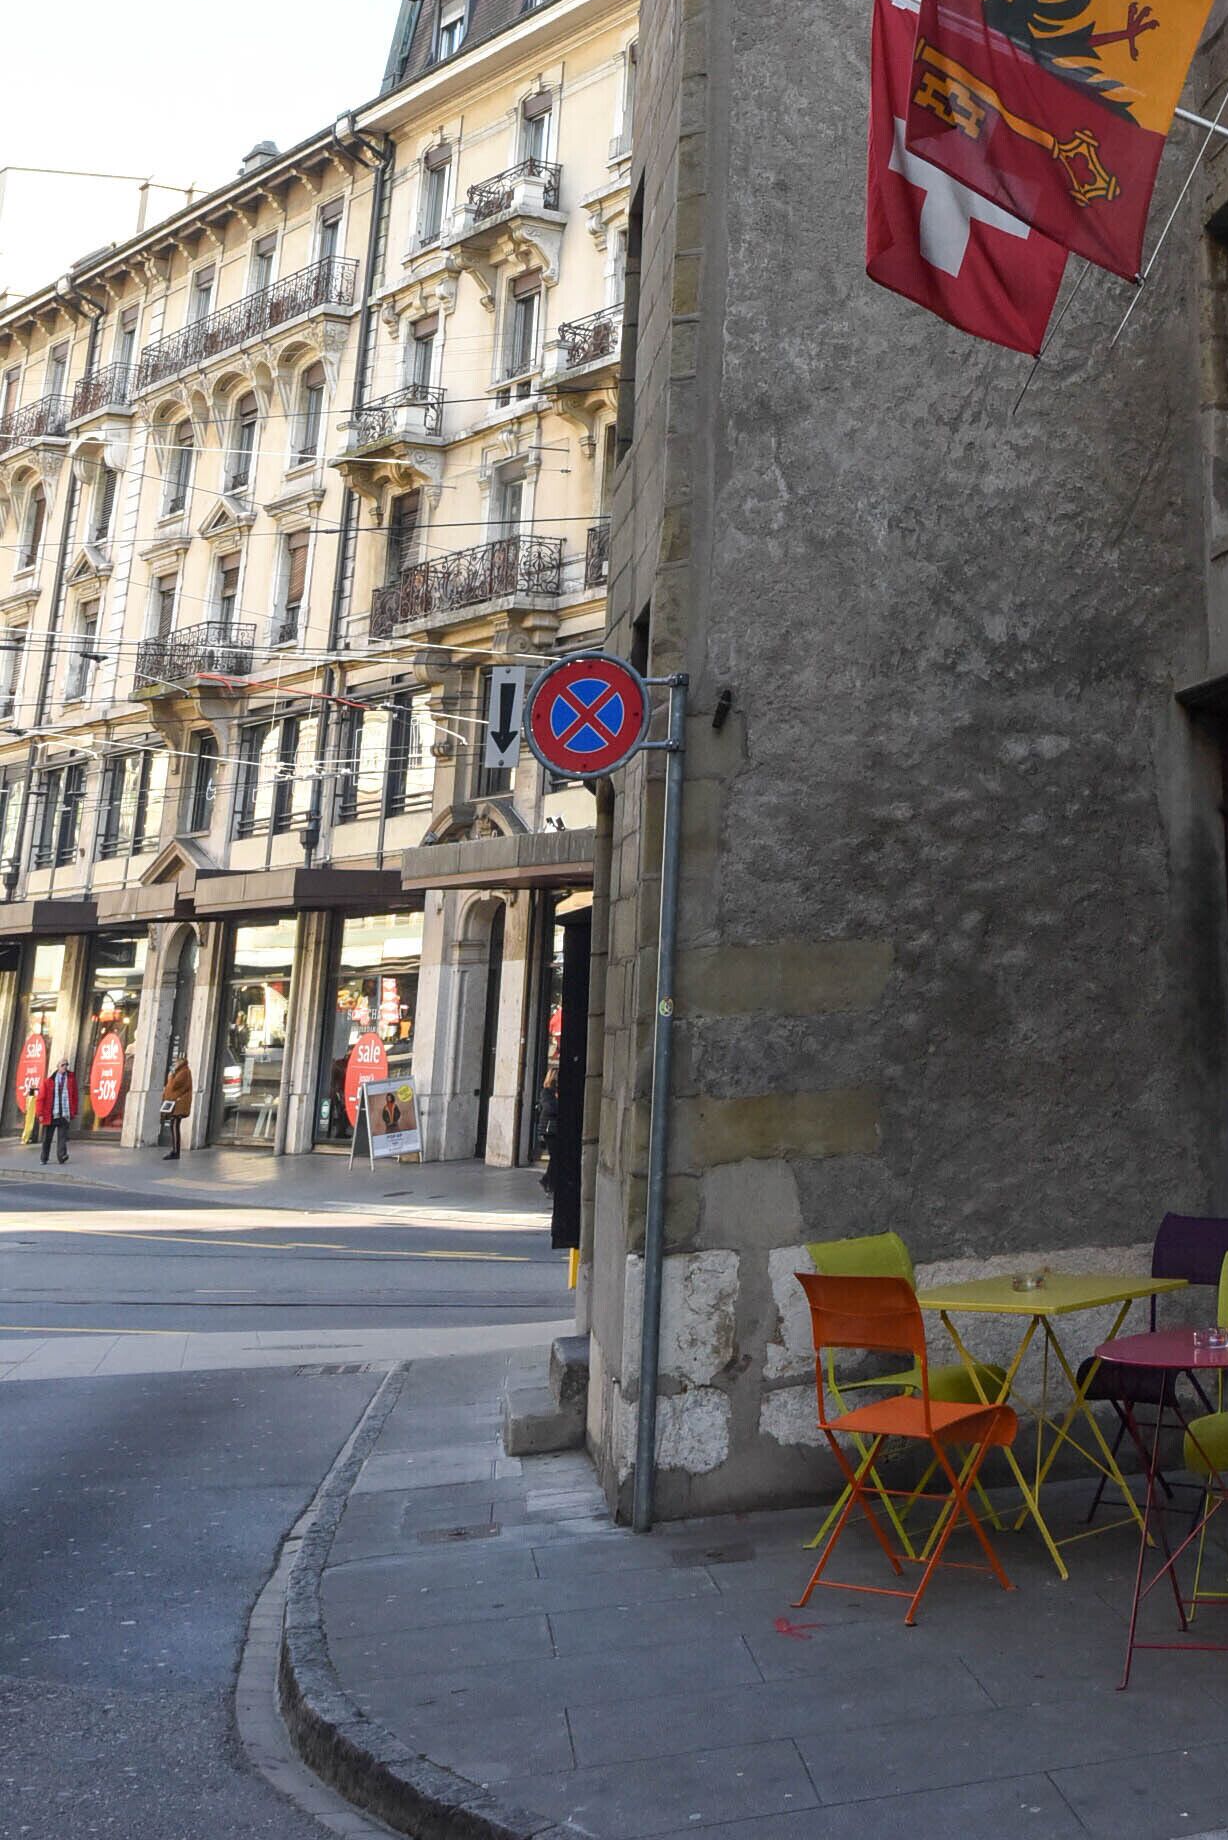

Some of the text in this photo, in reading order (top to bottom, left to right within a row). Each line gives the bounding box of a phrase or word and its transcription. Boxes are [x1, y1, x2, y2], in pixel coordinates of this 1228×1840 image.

[27, 1040, 42, 1057] sale
[101, 1040, 119, 1059] sale
[357, 1040, 381, 1063] sale
[94, 1080, 117, 1100] -50%
